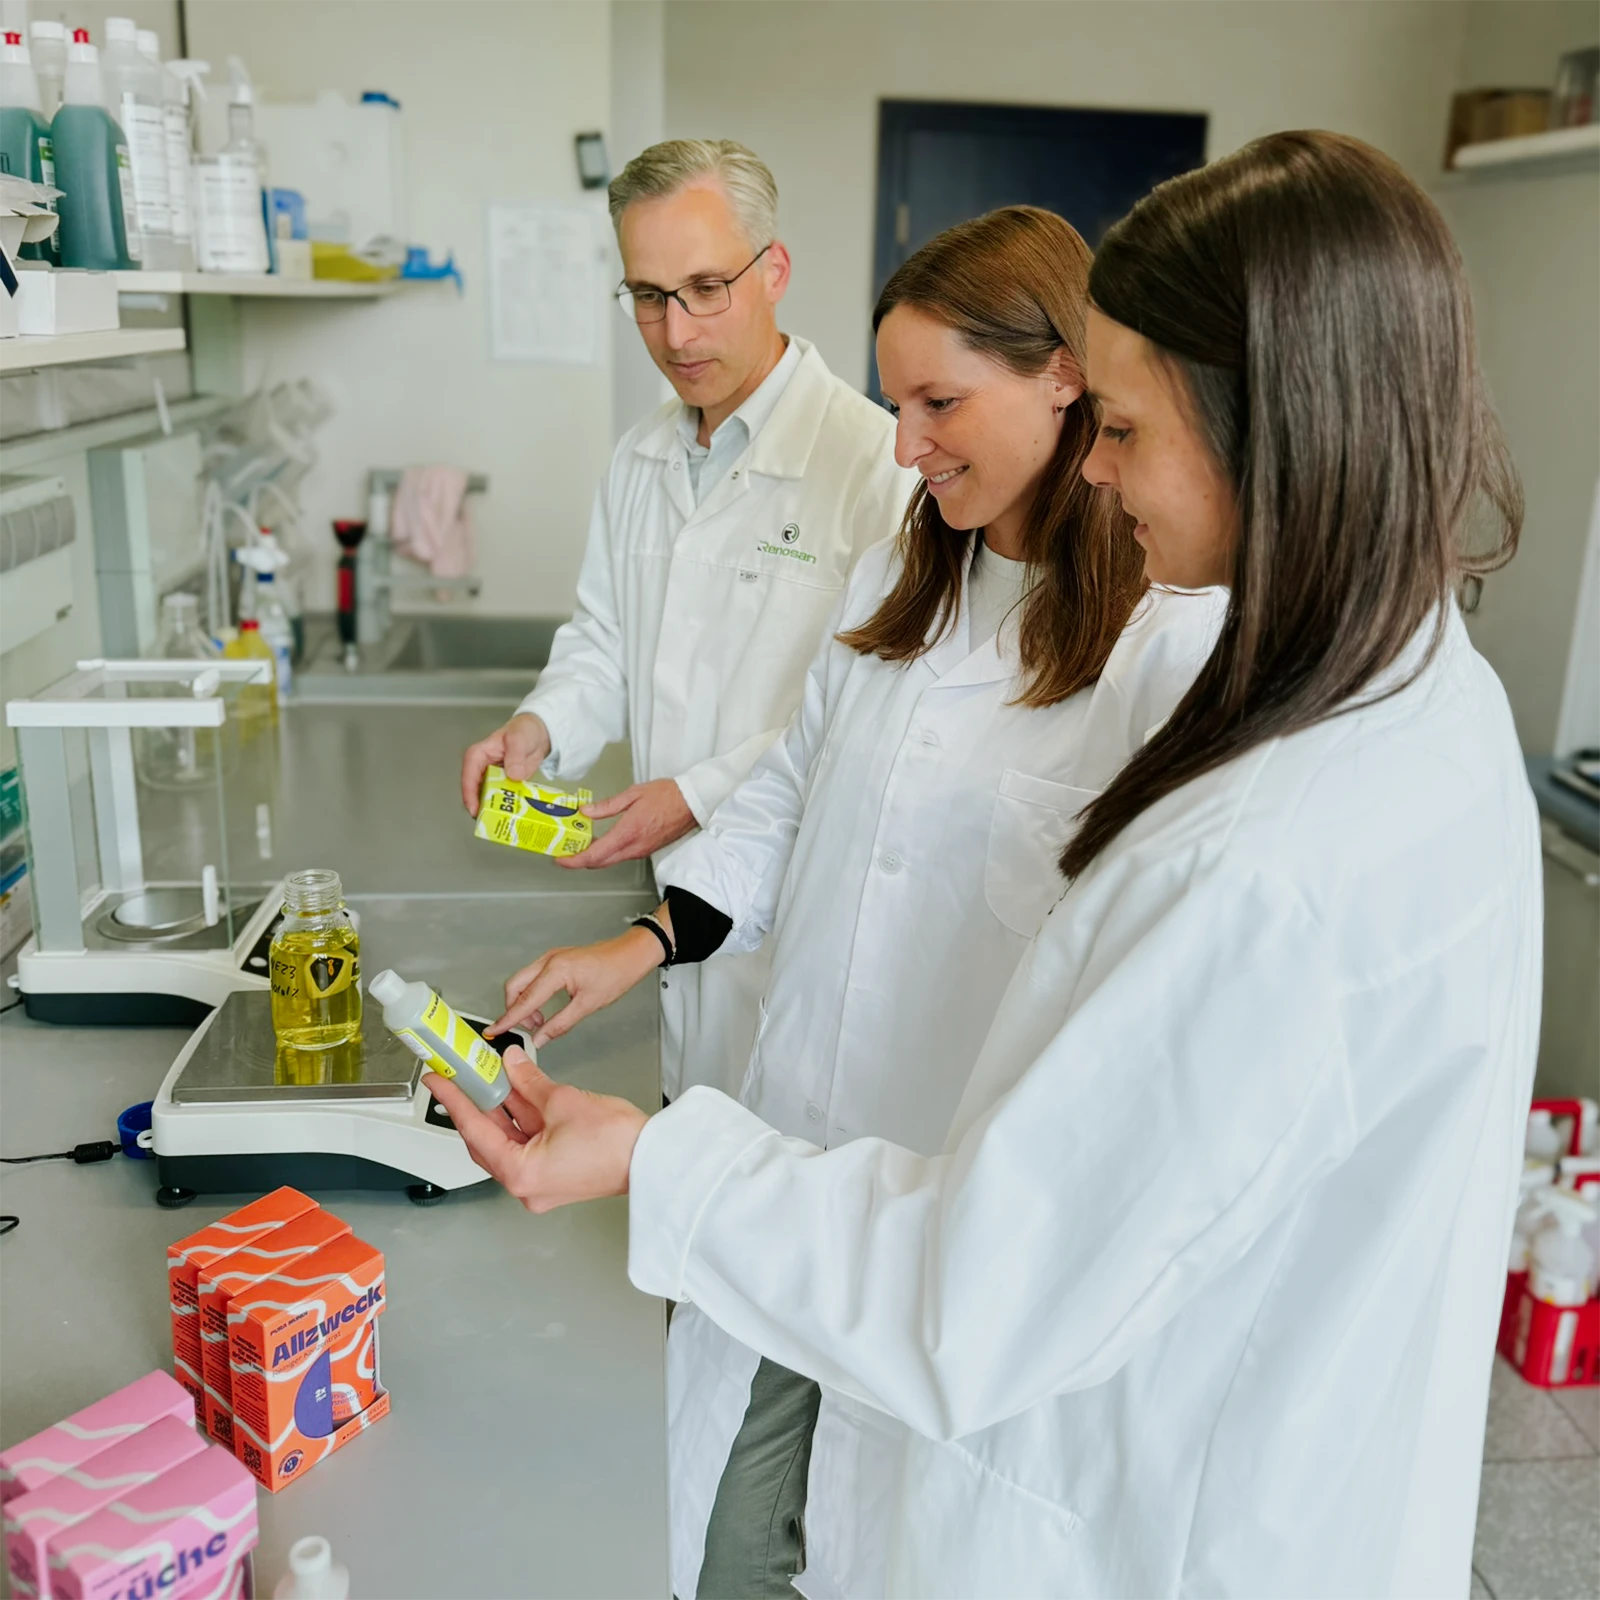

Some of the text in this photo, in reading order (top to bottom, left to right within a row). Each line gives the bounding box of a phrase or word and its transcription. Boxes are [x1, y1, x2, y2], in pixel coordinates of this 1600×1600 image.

[757, 540, 816, 564] Renosan
[500, 788, 515, 813] Bad
[272, 1285, 382, 1368] Allzweck
